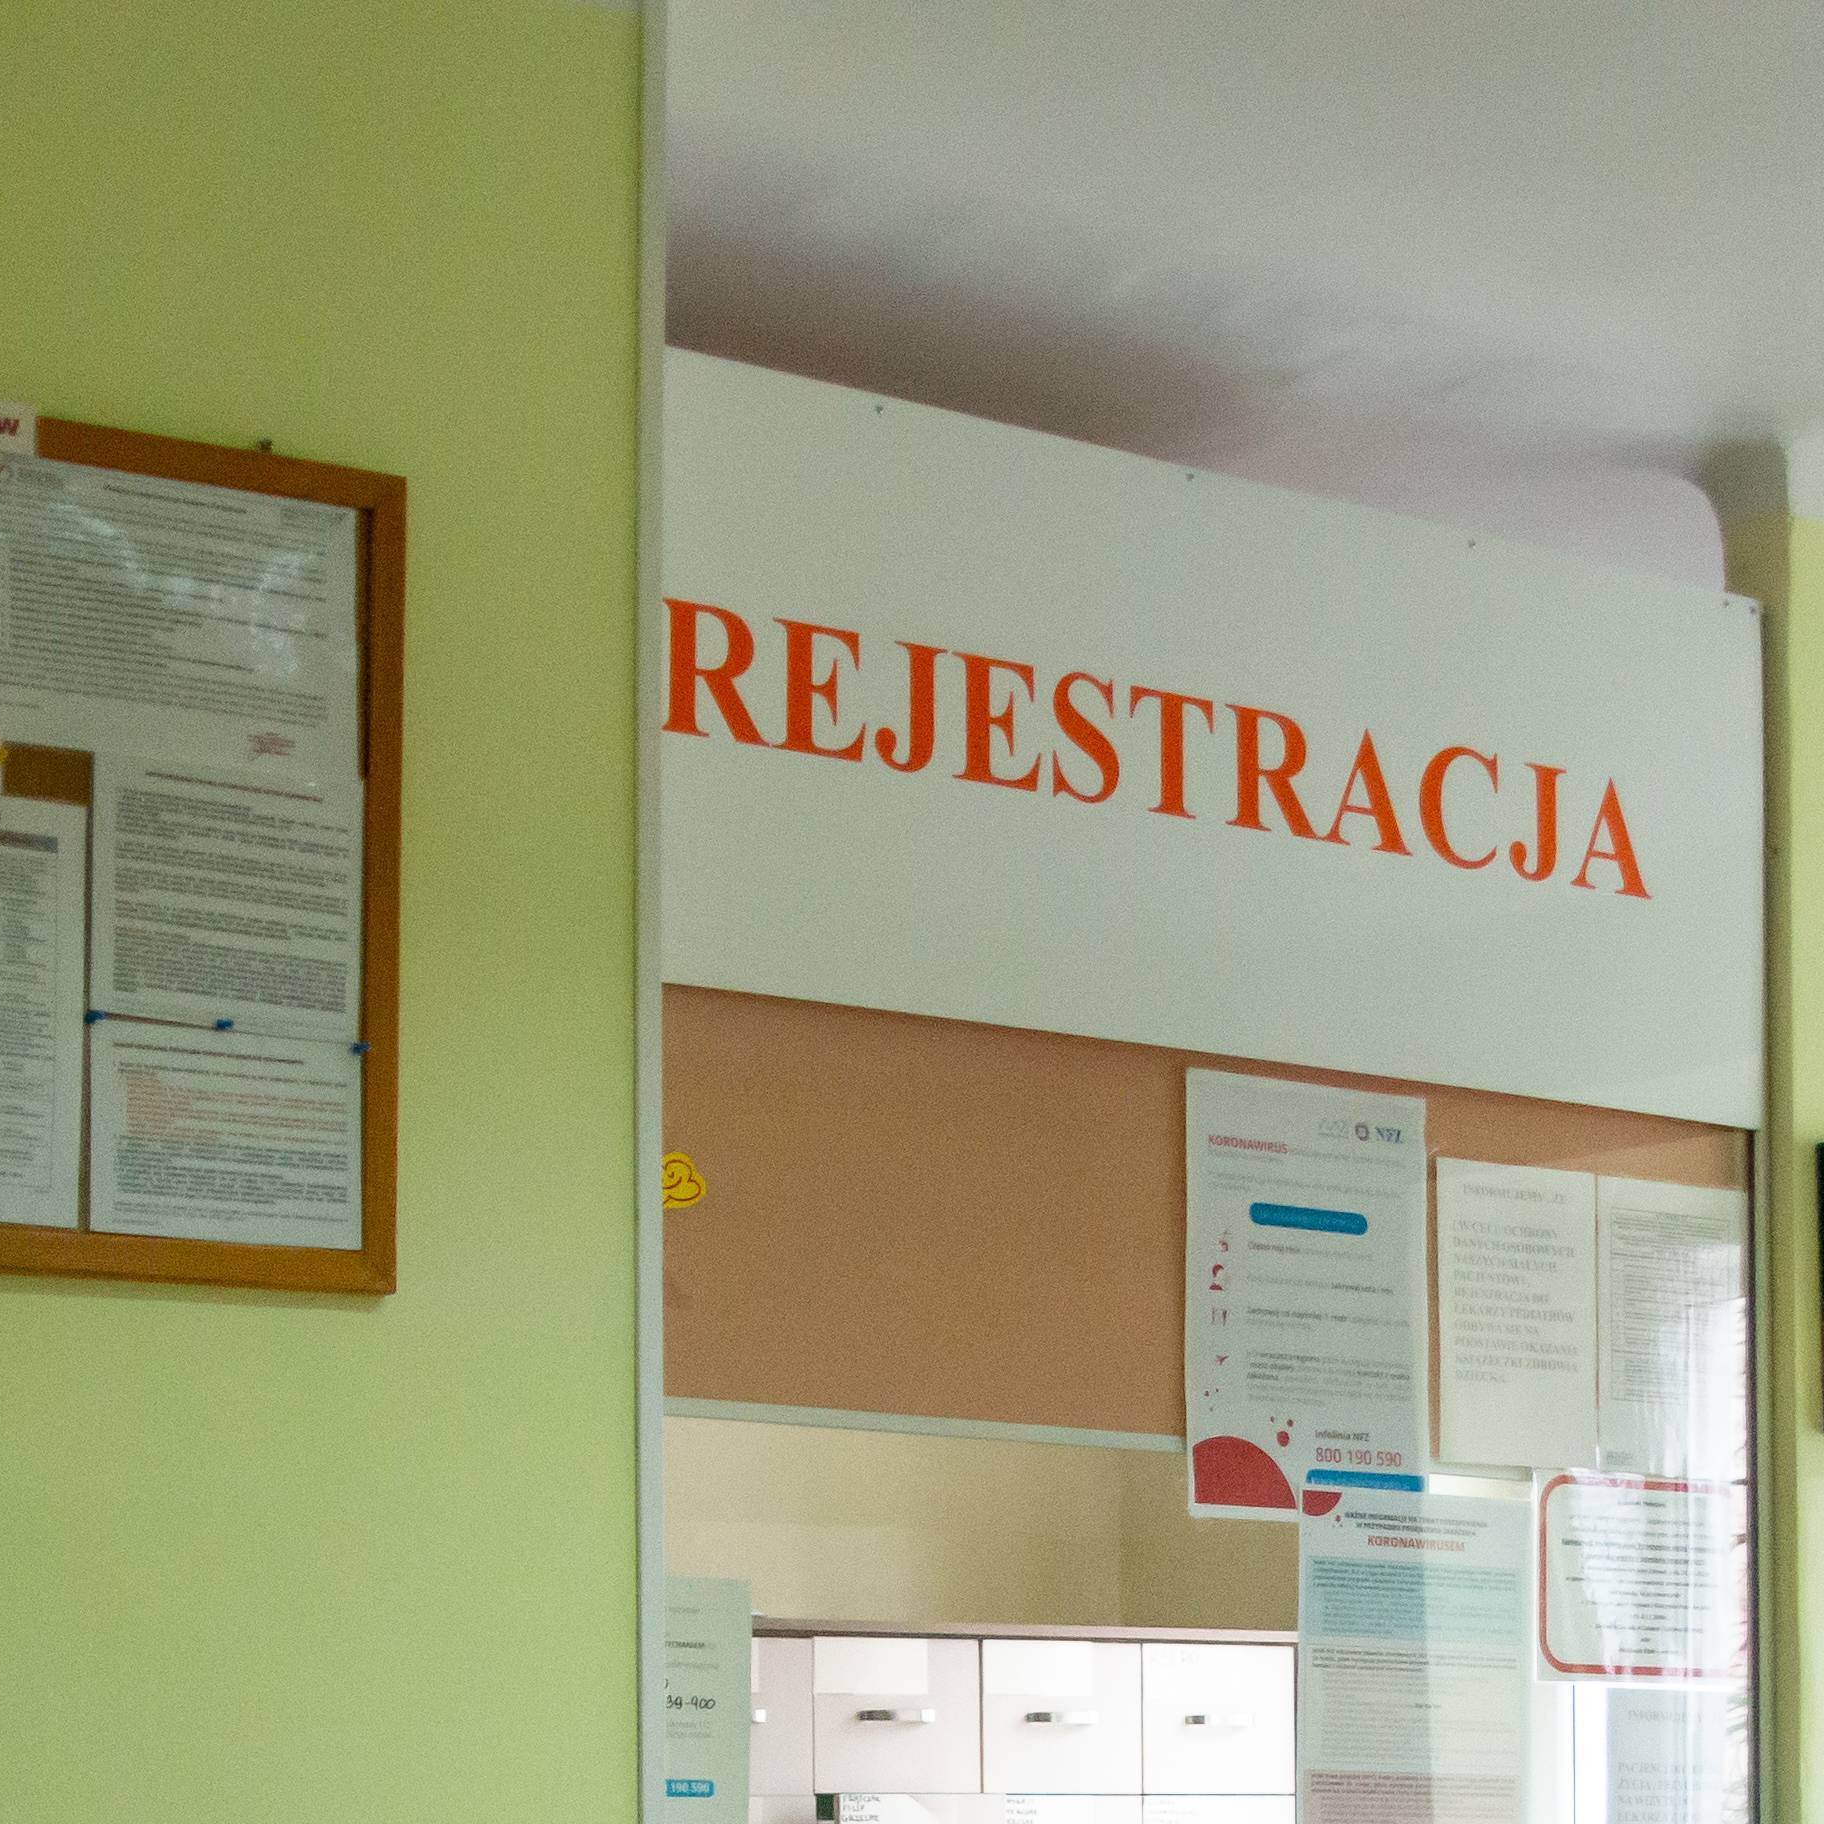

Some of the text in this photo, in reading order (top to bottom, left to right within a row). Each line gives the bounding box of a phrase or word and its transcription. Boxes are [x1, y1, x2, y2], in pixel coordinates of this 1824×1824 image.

[661, 597, 1653, 901] REJESTRACJA
[1207, 1133, 1289, 1155] KORONAWIRUS
[1375, 1125, 1405, 1145] NFZ
[1315, 1429, 1371, 1444] infolinia NFZ
[1314, 1445, 1403, 1469] 800 190 590
[1367, 1534, 1465, 1553] KORONAWIRUSEM
